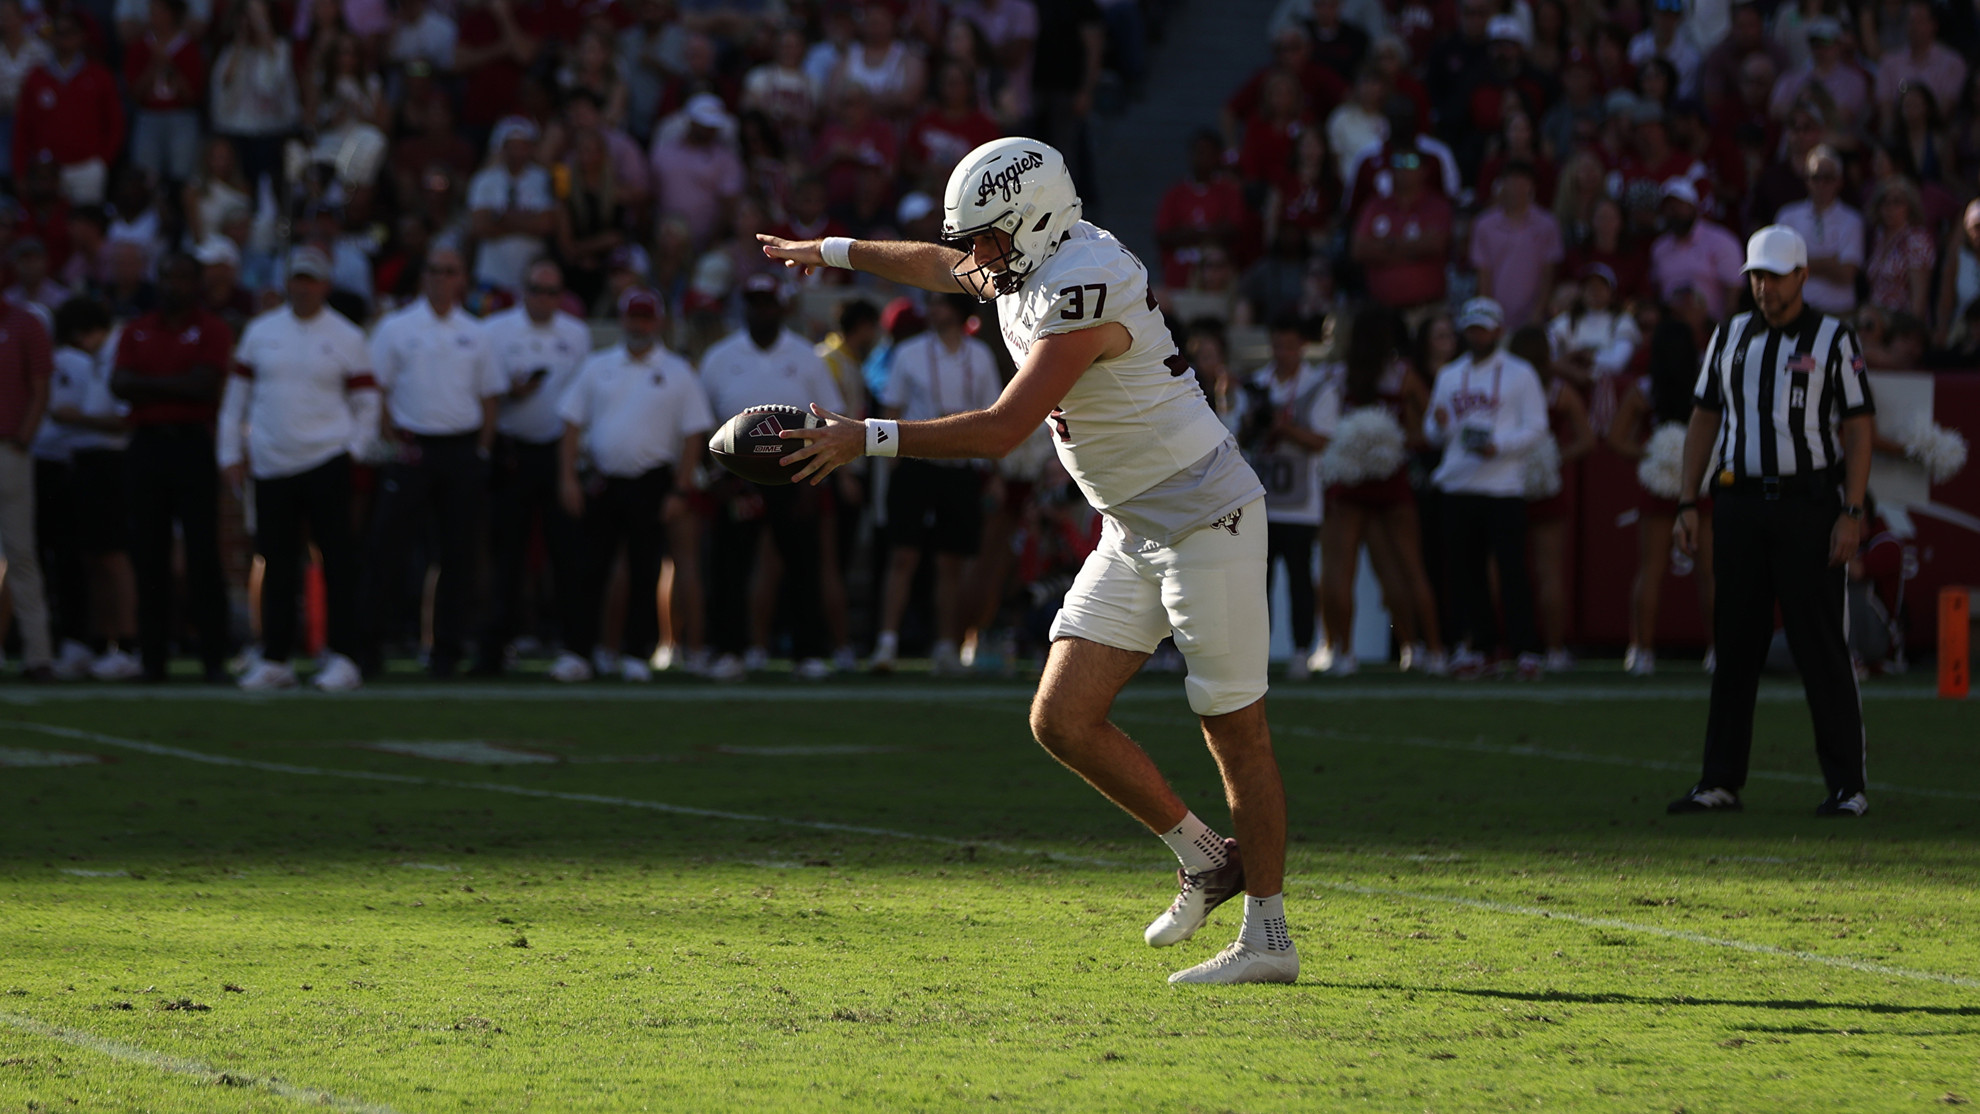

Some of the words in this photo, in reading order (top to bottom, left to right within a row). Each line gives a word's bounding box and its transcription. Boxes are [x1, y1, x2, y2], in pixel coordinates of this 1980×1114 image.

[975, 154, 1043, 206] Aggies
[1060, 283, 1107, 320] 37
[1791, 386, 1805, 408] R
[753, 444, 783, 452] DIME
